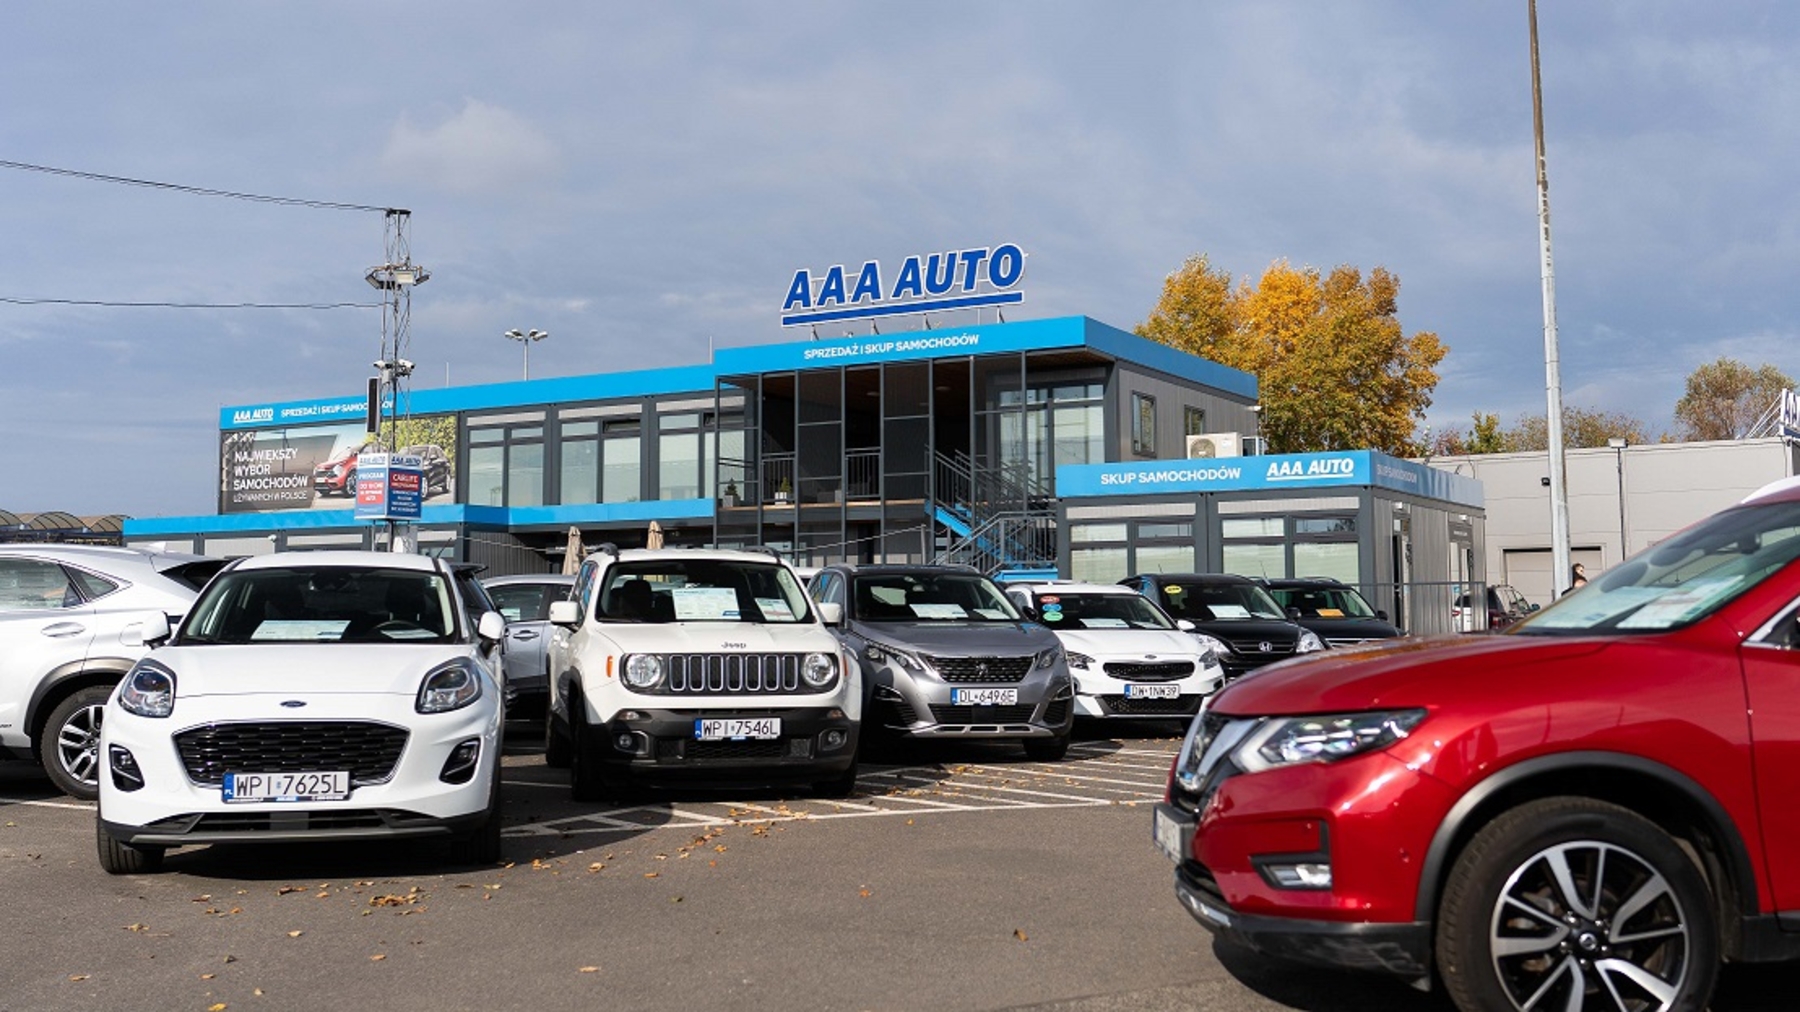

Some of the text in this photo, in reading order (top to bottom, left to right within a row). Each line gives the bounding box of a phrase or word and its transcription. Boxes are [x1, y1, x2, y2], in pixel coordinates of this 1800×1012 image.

[780, 242, 1026, 312] AAA AUTO
[803, 344, 859, 360] SPRZEDAŻ
[864, 341, 895, 355] SKUP
[895, 333, 980, 352] SAMOCHODÓW
[233, 408, 274, 421] AAA AUTO
[280, 406, 318, 418] SPRZEDAŻ
[321, 404, 341, 414] SKUP
[234, 447, 298, 464] NAJWIĘKSZY
[1100, 465, 1241, 485] SKUP SAMOCHODÓW
[1266, 457, 1355, 478] AAA AUTO
[233, 474, 309, 491] SAMOCHODÓW
[959, 689, 1016, 702] DL 6496E
[703, 720, 778, 736] WPI 7546L
[236, 774, 345, 797] WPI 7625L
